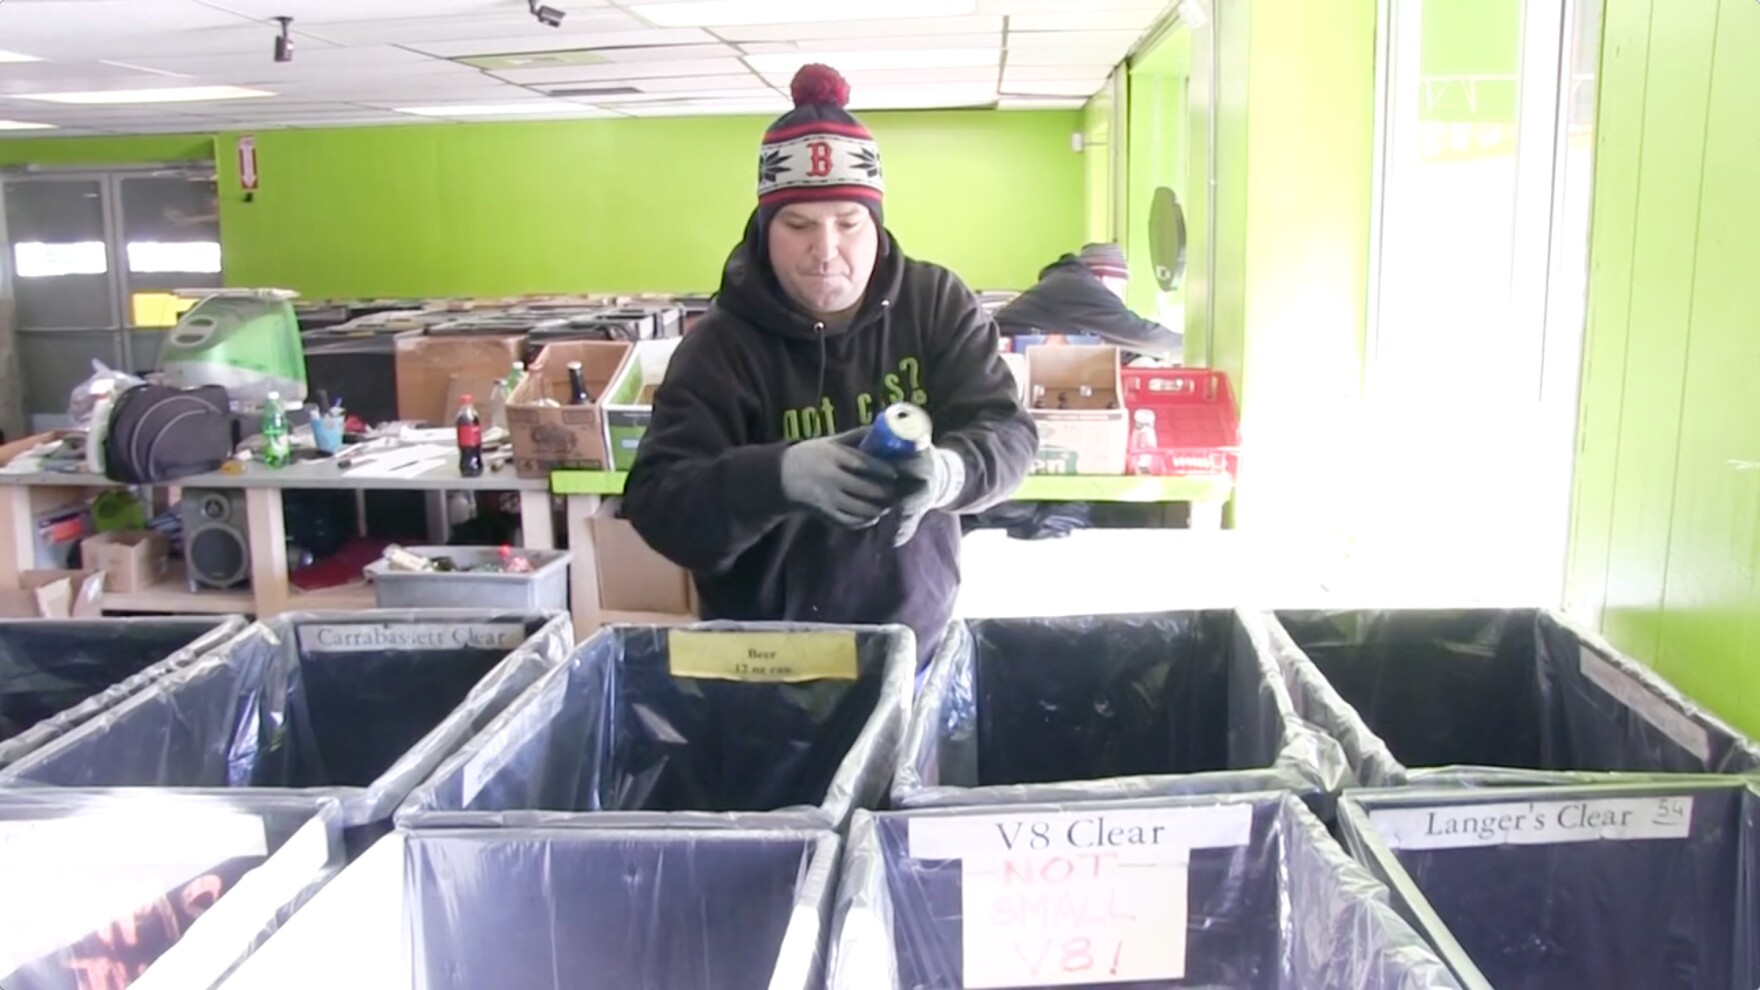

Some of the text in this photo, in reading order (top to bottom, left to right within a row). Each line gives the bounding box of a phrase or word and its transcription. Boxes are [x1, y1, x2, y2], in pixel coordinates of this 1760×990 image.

[806, 141, 833, 177] B
[857, 357, 926, 425] cs?
[734, 664, 748, 674] 12
[747, 648, 776, 660] Beer
[1425, 802, 1634, 839] Langer's Clear
[1656, 799, 1685, 818] 54
[995, 817, 1166, 850] V8 Clear
[1002, 852, 1119, 887] NOT
[990, 889, 1137, 929] SMALL
